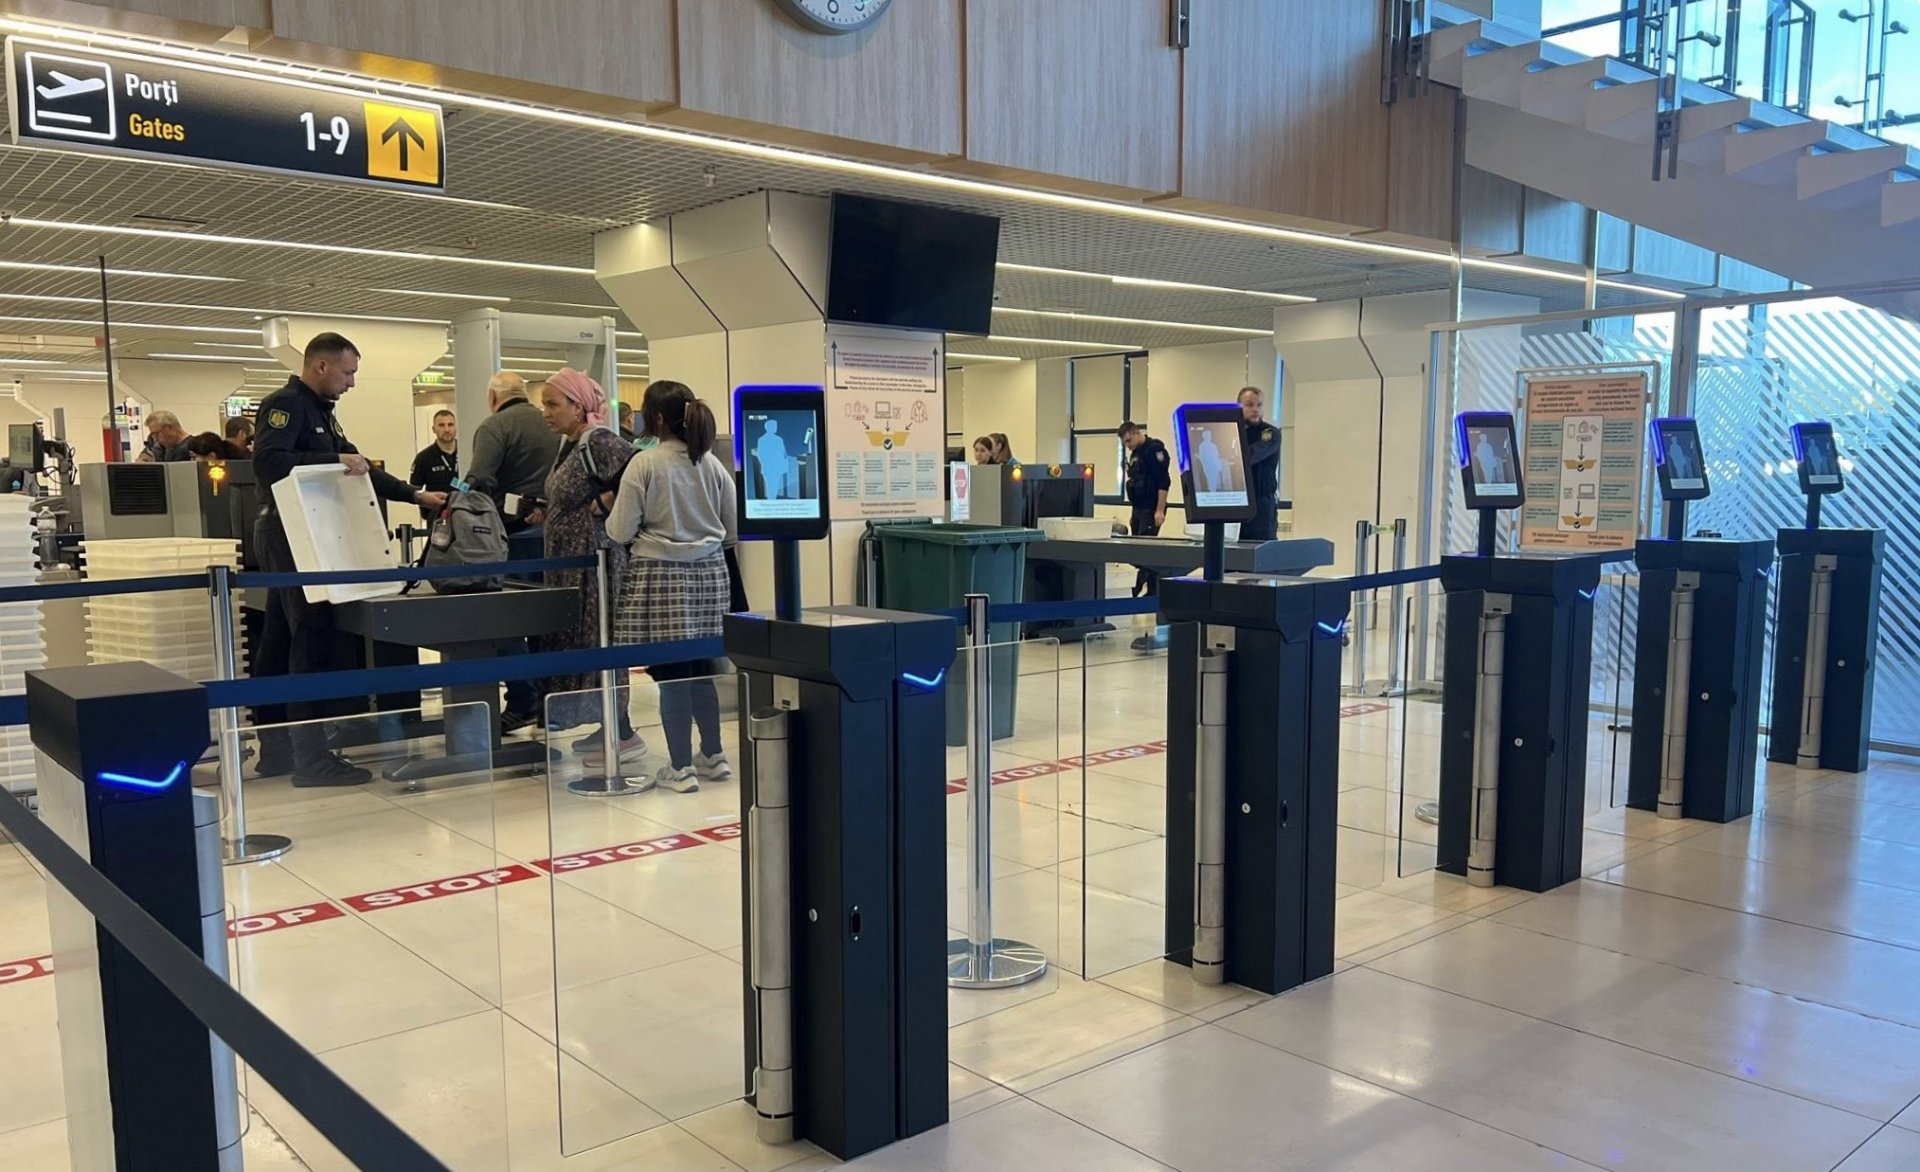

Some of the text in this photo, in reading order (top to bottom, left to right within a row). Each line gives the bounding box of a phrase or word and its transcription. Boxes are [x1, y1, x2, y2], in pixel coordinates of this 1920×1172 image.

[129, 113, 185, 141] Gates
[300, 112, 350, 155] 1-9
[988, 765, 1053, 784] TOP
[552, 836, 682, 870] STOP
[363, 869, 513, 908] STOP
[228, 908, 317, 932] OP
